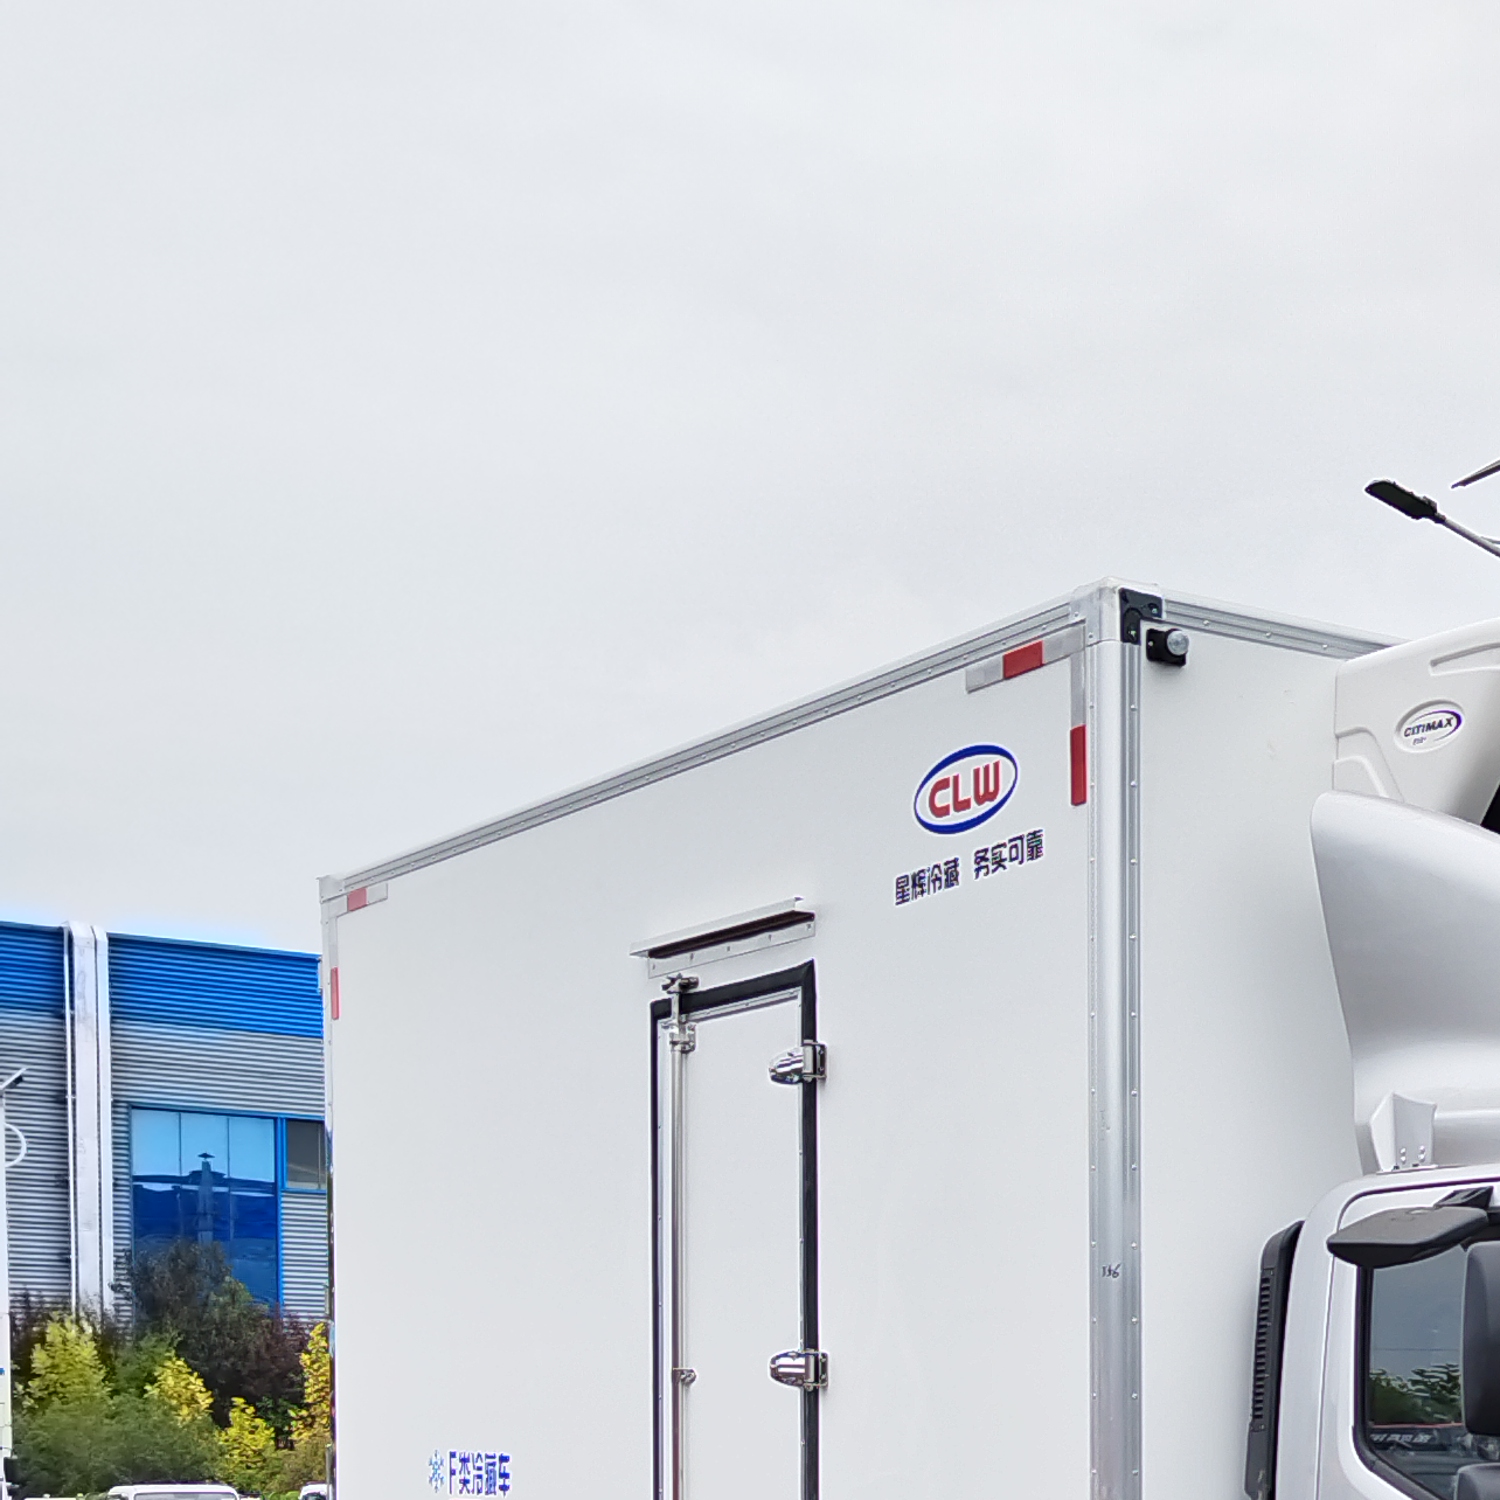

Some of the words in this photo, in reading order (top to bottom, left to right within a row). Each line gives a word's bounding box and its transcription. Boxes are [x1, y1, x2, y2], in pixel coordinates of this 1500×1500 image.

[929, 760, 1000, 818] CLW
[974, 829, 1044, 880] 务实可靠
